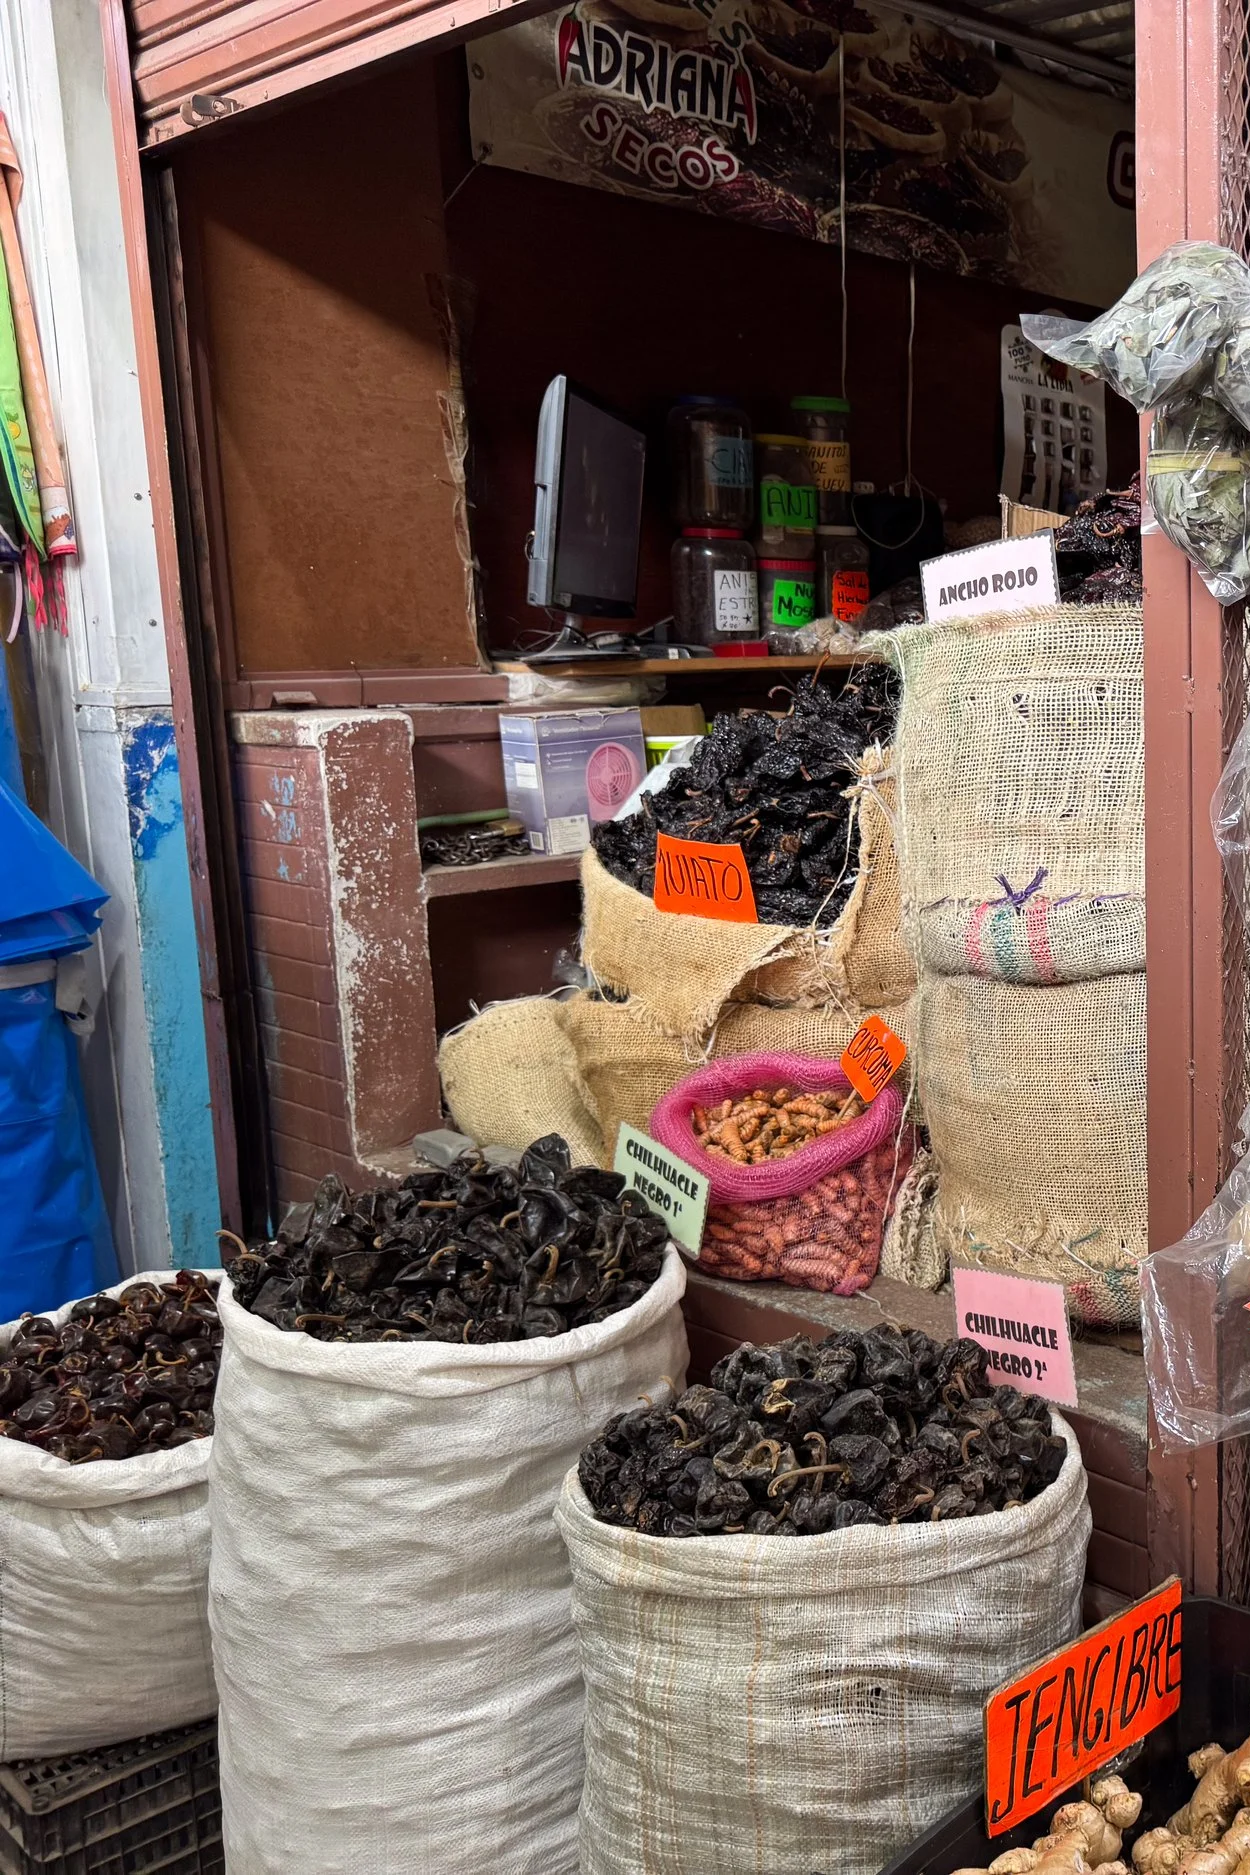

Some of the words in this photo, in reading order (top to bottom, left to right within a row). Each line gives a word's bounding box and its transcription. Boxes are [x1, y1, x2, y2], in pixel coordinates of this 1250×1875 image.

[558, 13, 756, 142] ADRIANA
[581, 105, 737, 188] SECOS
[939, 577, 989, 606] ANCHO
[992, 566, 1038, 593] ROJO
[626, 1139, 699, 1201] CHILHUACLE
[633, 1171, 671, 1211] NEGRO
[965, 1312, 1058, 1350] CHILHUACLE
[991, 1605, 1182, 1824] JENGIBRE
